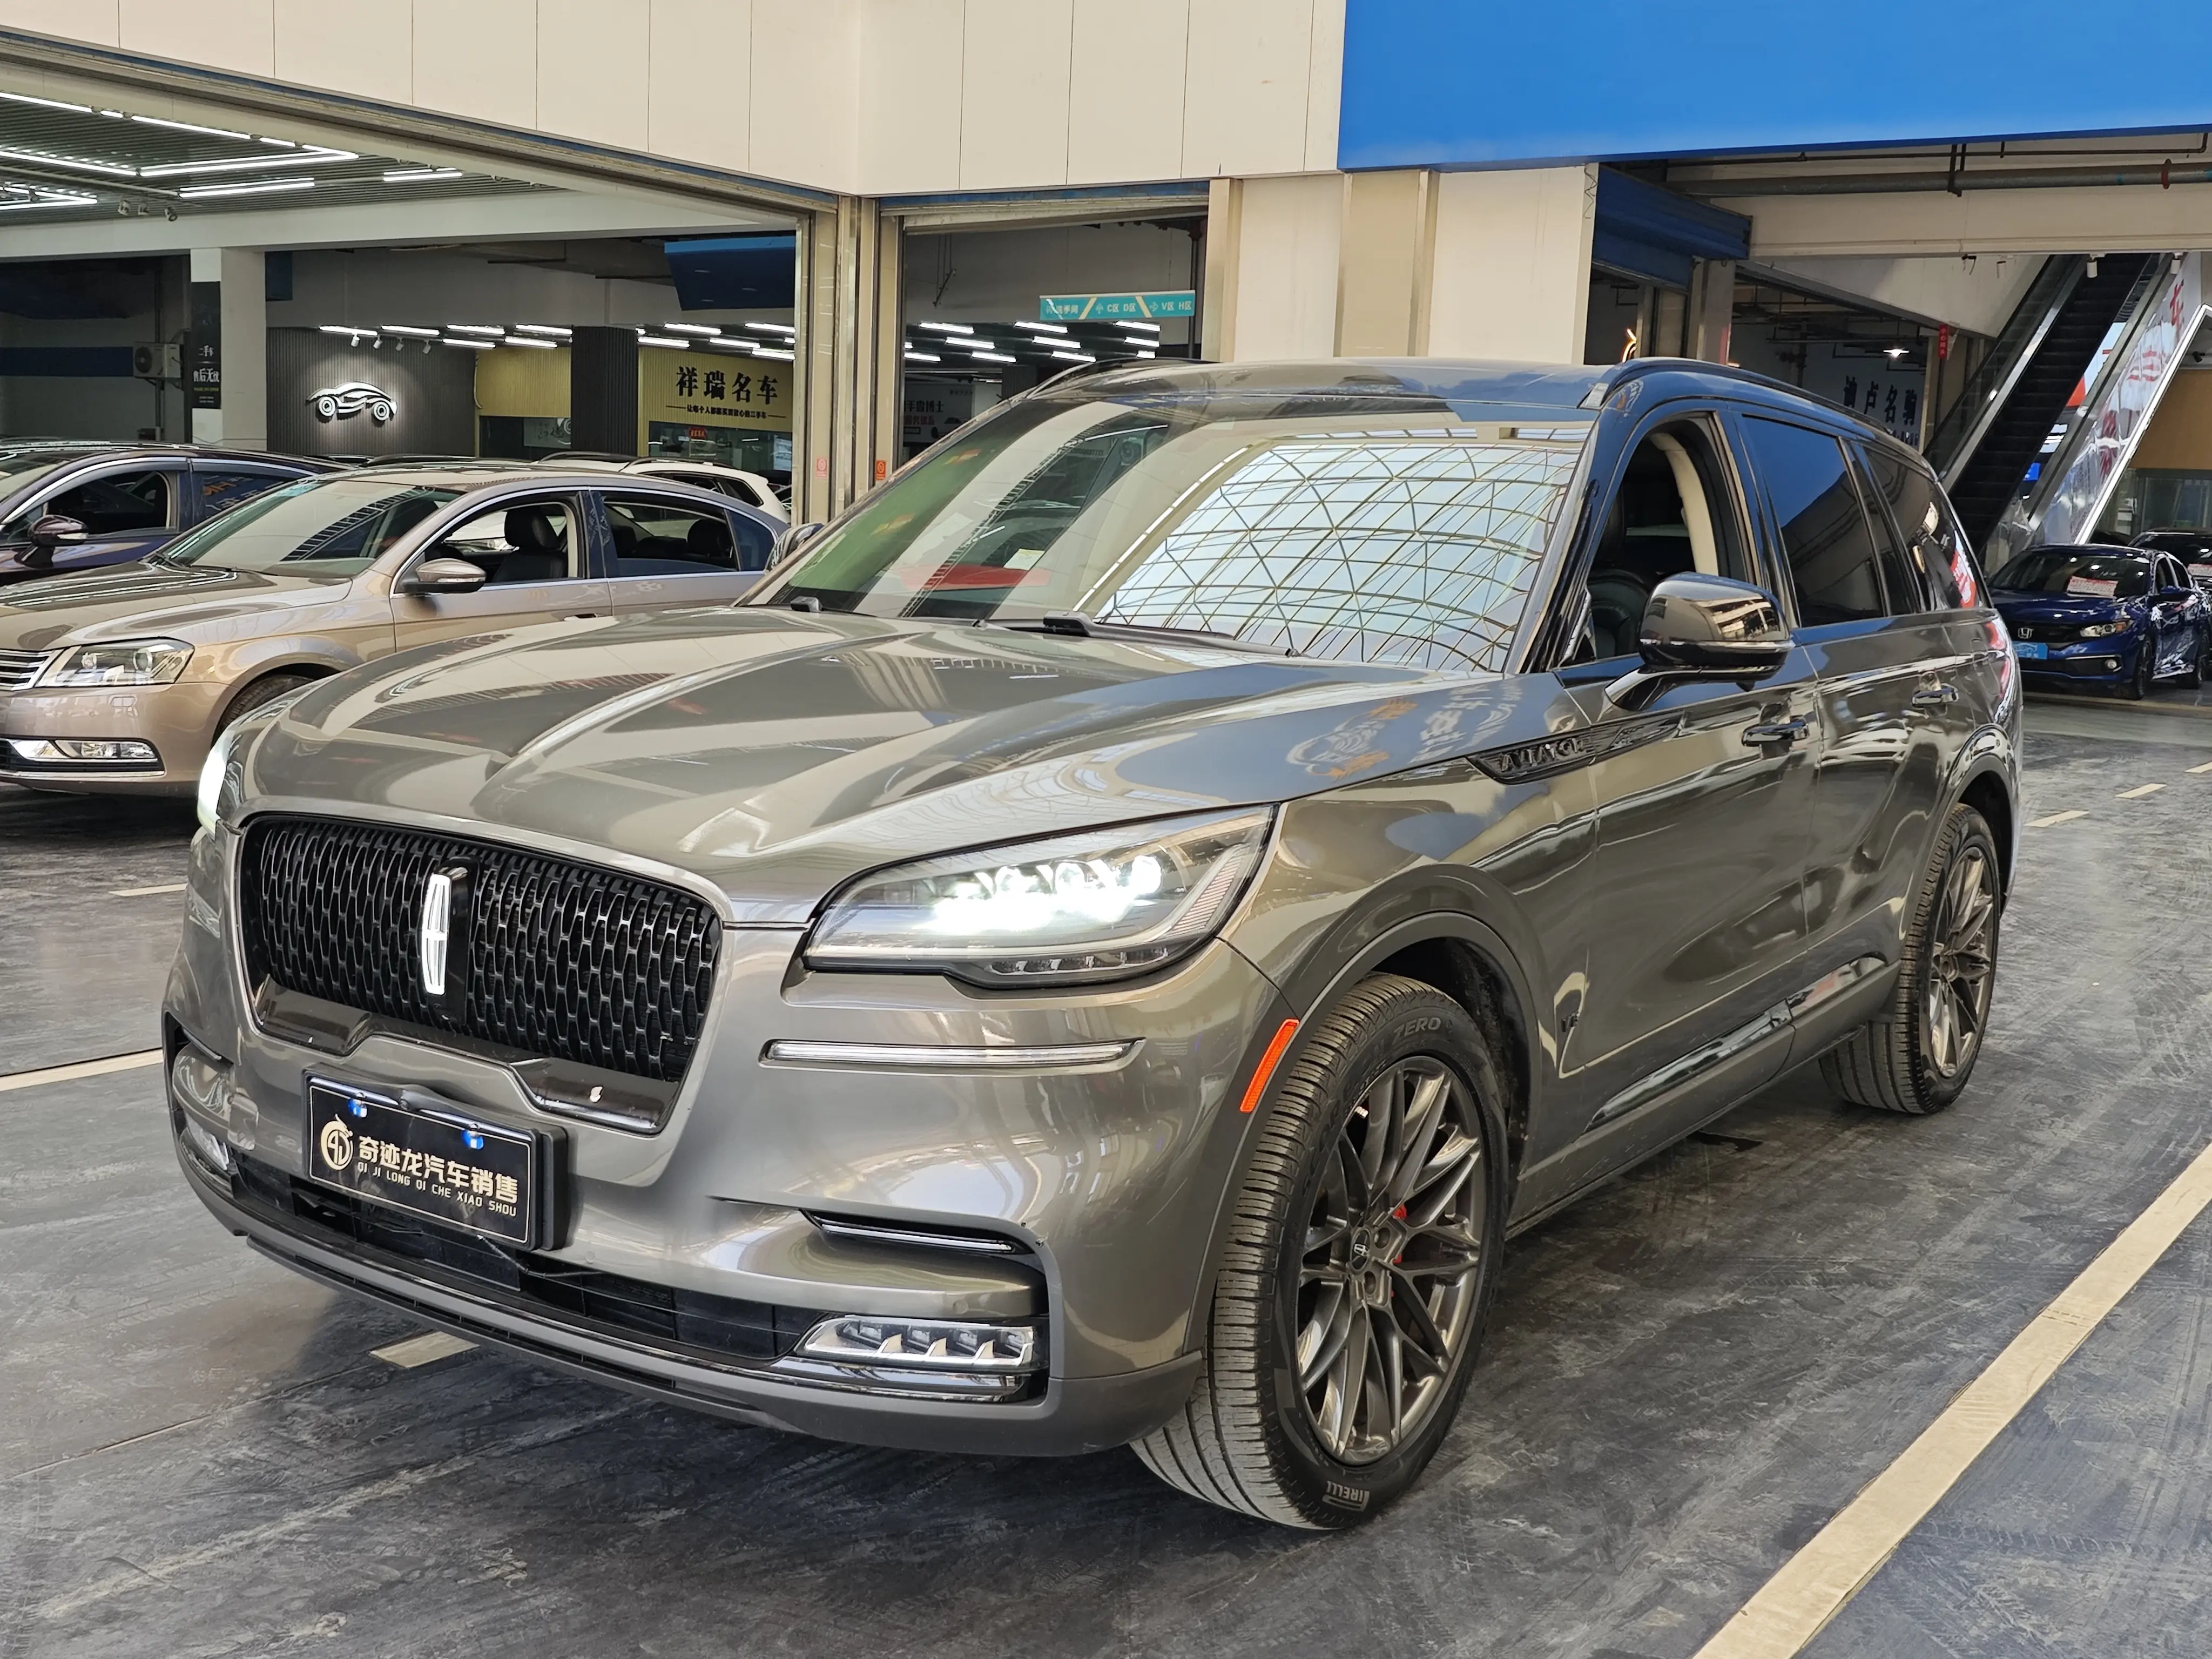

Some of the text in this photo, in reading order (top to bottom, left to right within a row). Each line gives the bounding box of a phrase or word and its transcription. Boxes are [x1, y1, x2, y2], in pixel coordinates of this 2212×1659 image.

[1107, 302, 1136, 313] C区 D区
[1162, 300, 1192, 312] V区 H区
[676, 366, 778, 405] 祥瑞名车
[1500, 738, 1587, 773] AVIATOR
[1393, 1017, 1441, 1042] ZERO
[358, 1135, 518, 1204] 奇迹龙汽车销售
[357, 1162, 517, 1217] QI JI LONG QI CHE XIAO SHOU
[1322, 1480, 1370, 1512] PIRELLI
